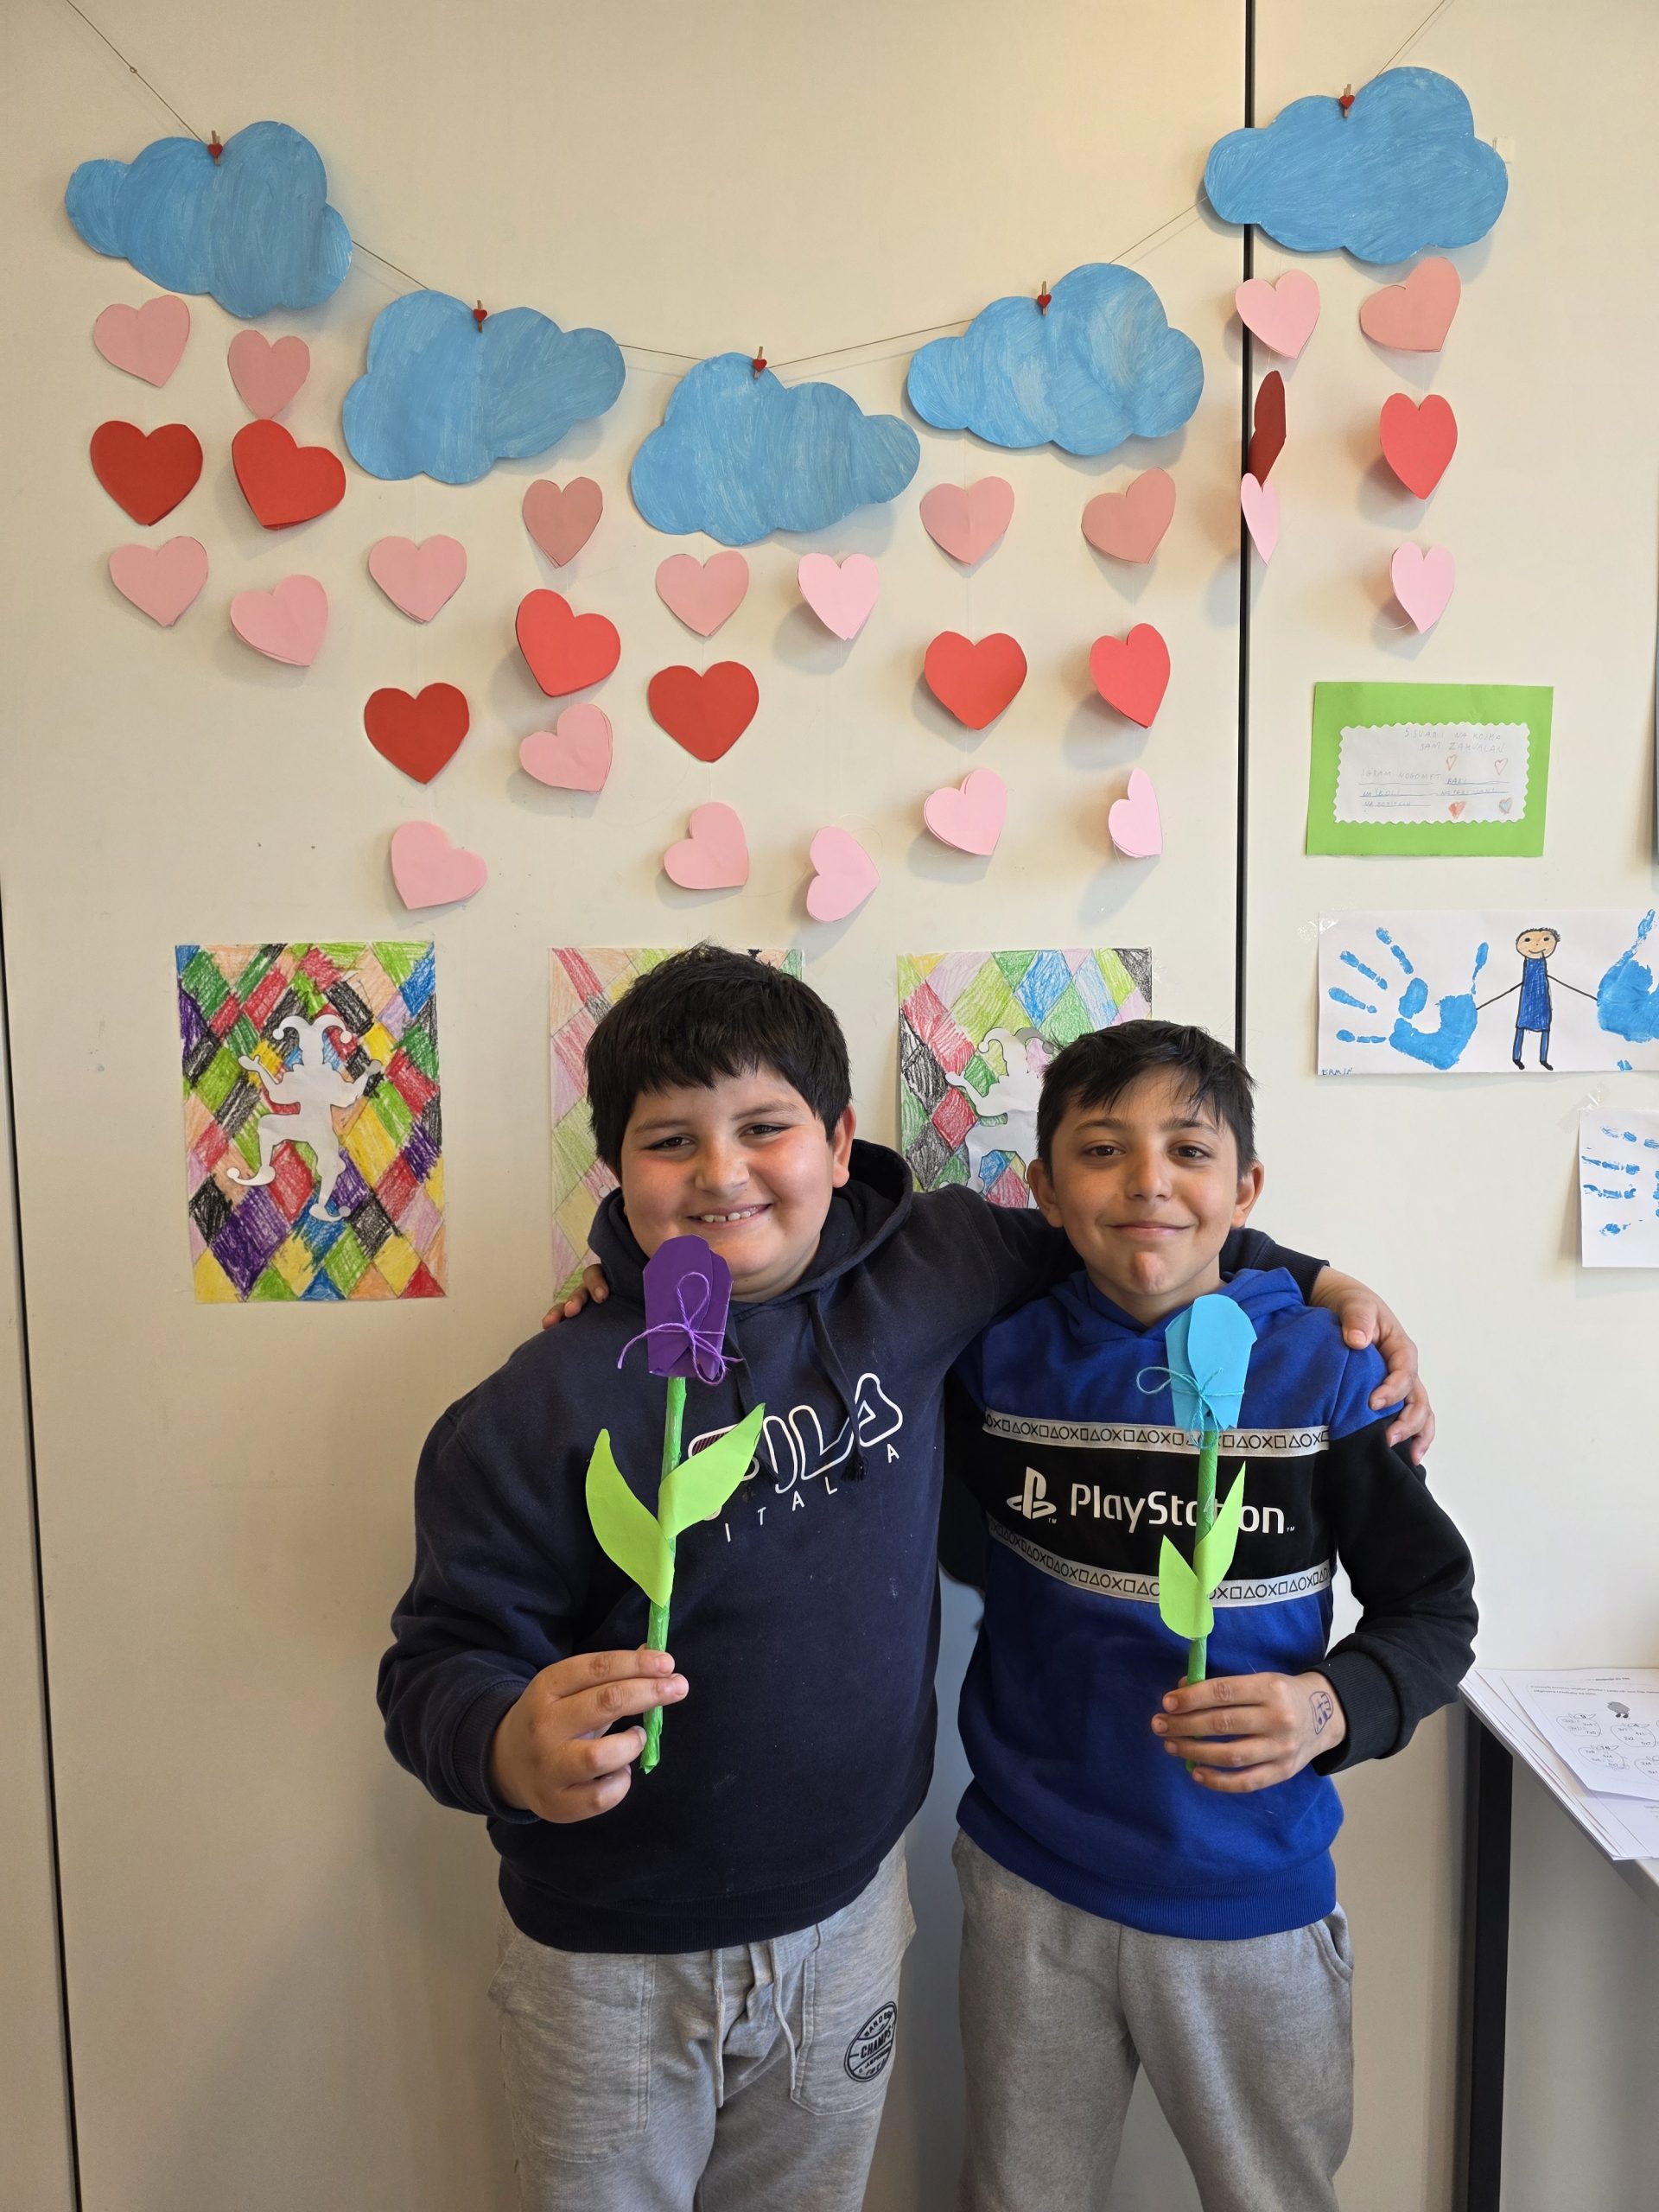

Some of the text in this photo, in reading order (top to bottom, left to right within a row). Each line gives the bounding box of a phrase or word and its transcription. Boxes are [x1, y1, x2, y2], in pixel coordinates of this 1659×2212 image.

[1321, 1066, 1353, 1076] ERMIN
[723, 1443, 900, 1542] ITALA
[1071, 1483, 1285, 1534] PlayStaton
